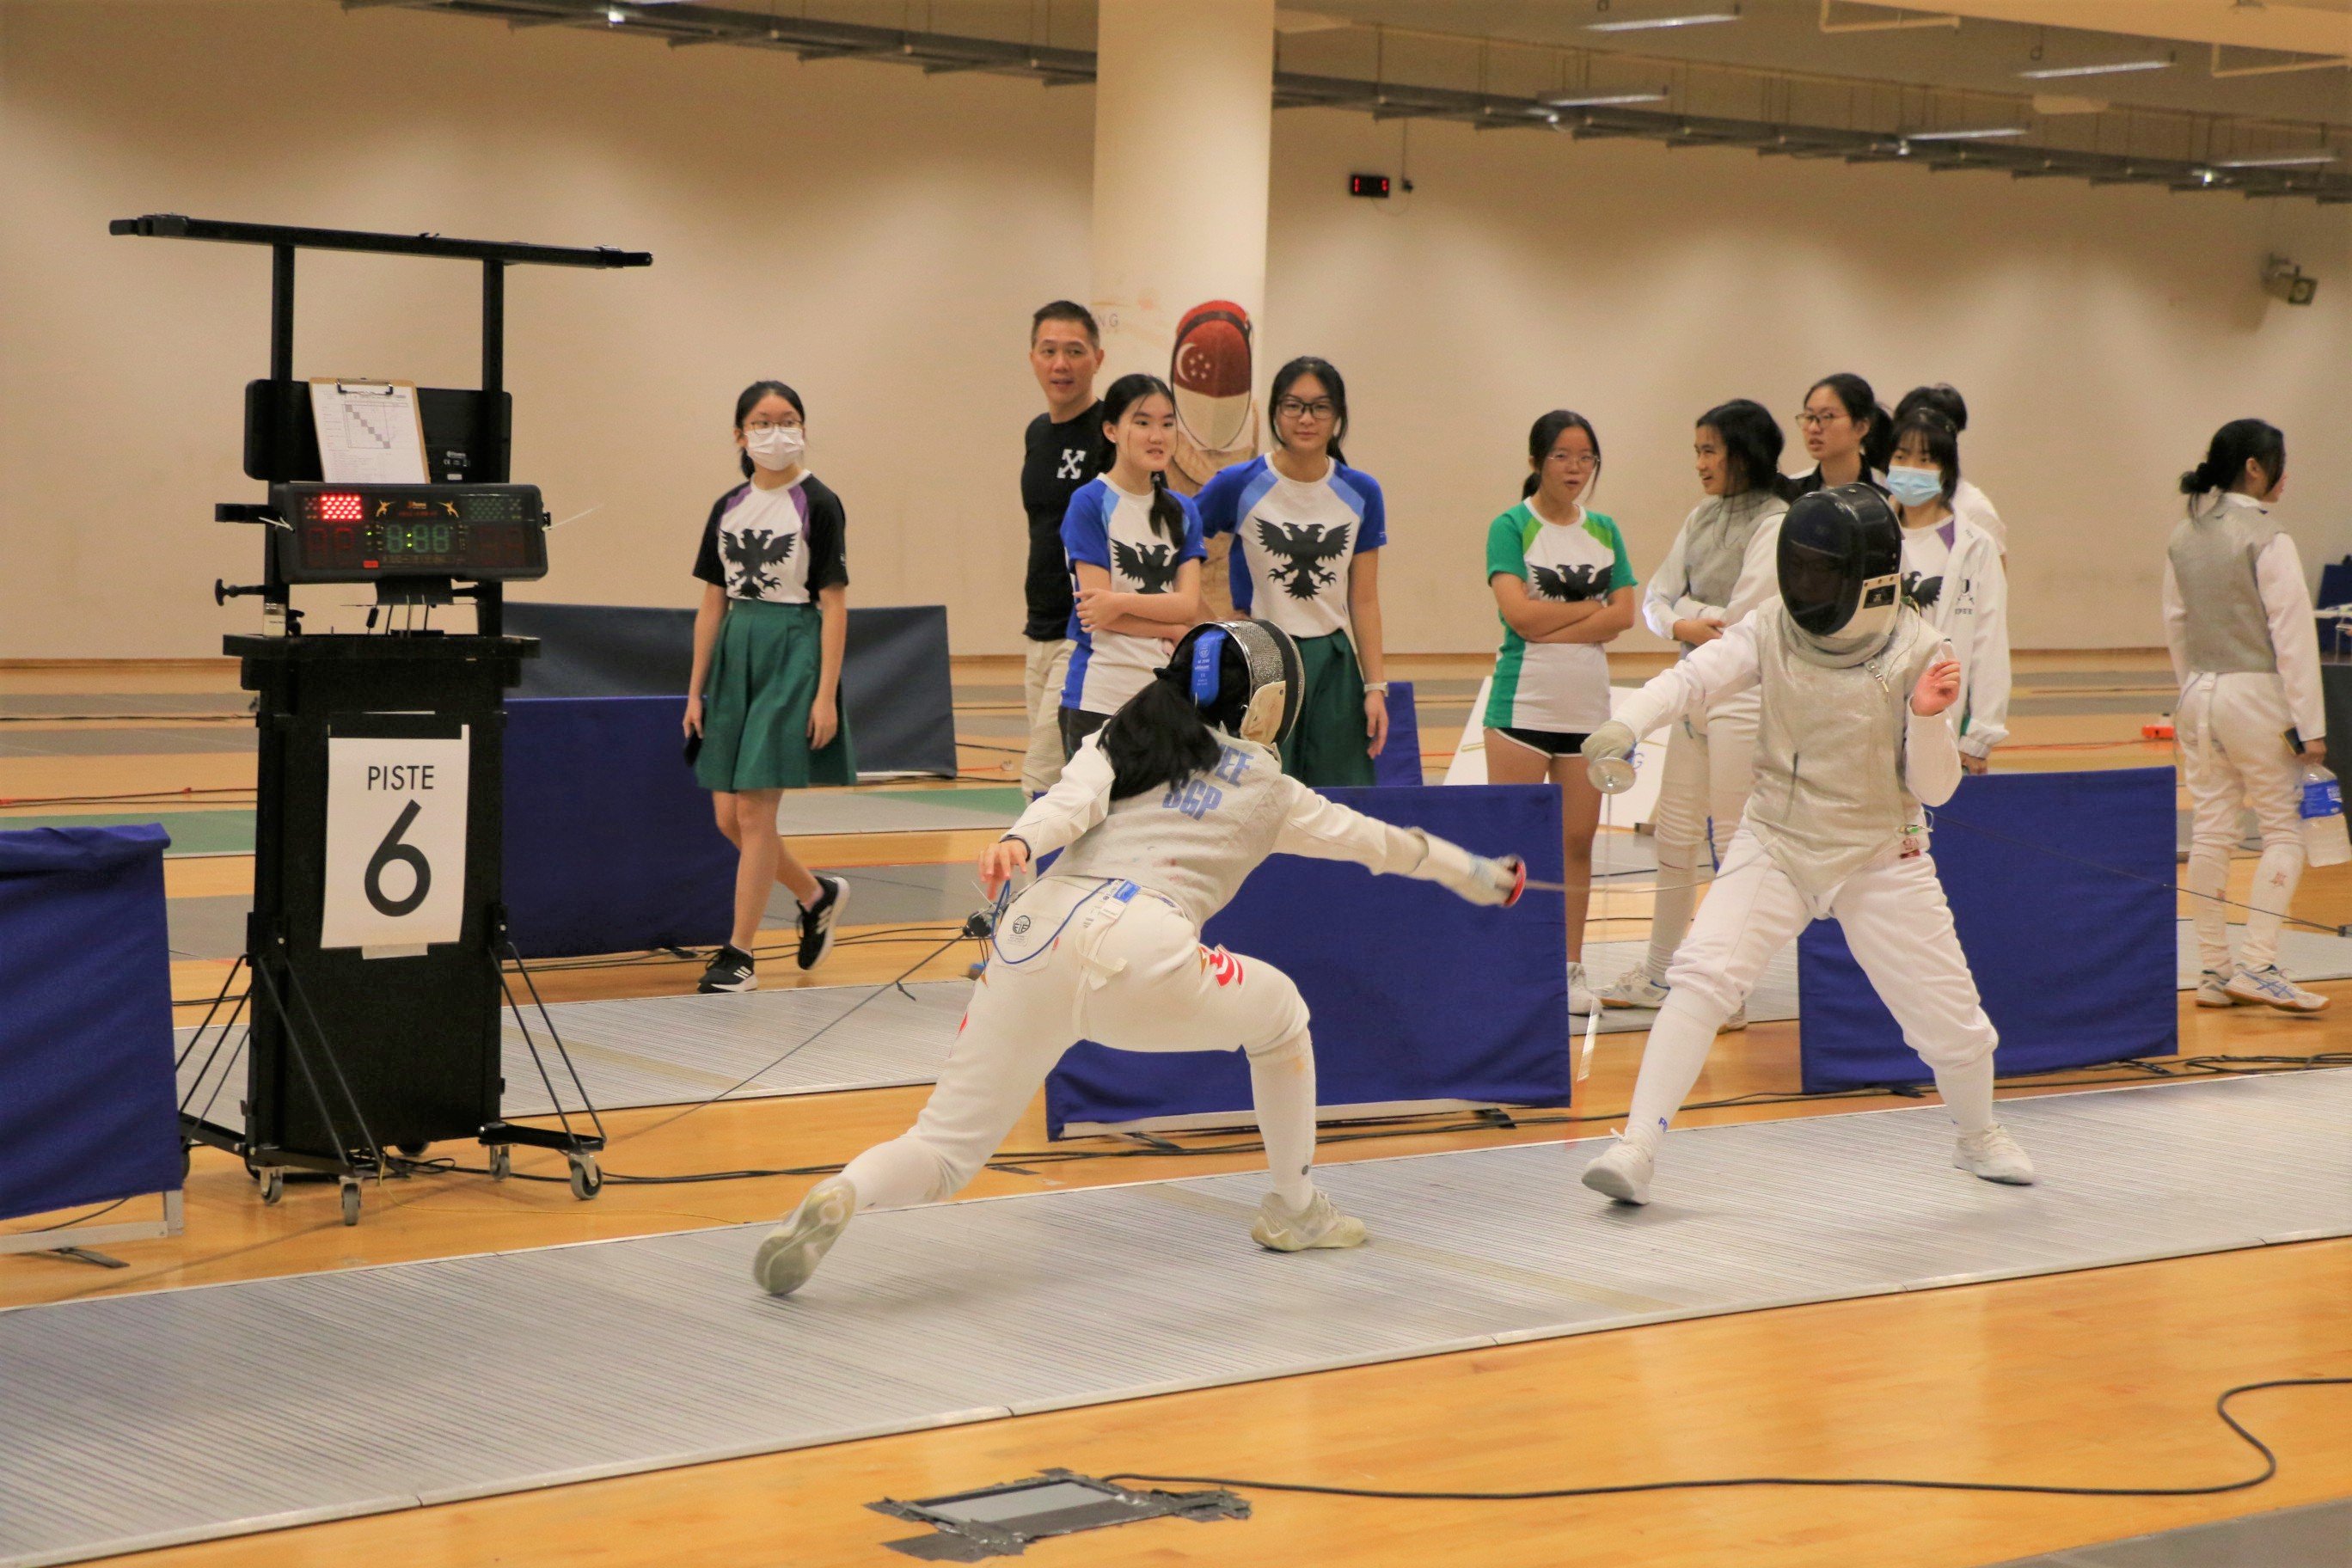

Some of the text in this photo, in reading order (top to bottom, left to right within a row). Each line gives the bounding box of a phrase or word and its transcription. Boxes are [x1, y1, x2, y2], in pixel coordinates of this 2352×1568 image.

[367, 765, 434, 791] PISTE
[1215, 744, 1254, 787] EE
[1162, 779, 1223, 820] SGP
[364, 799, 432, 917] 6
